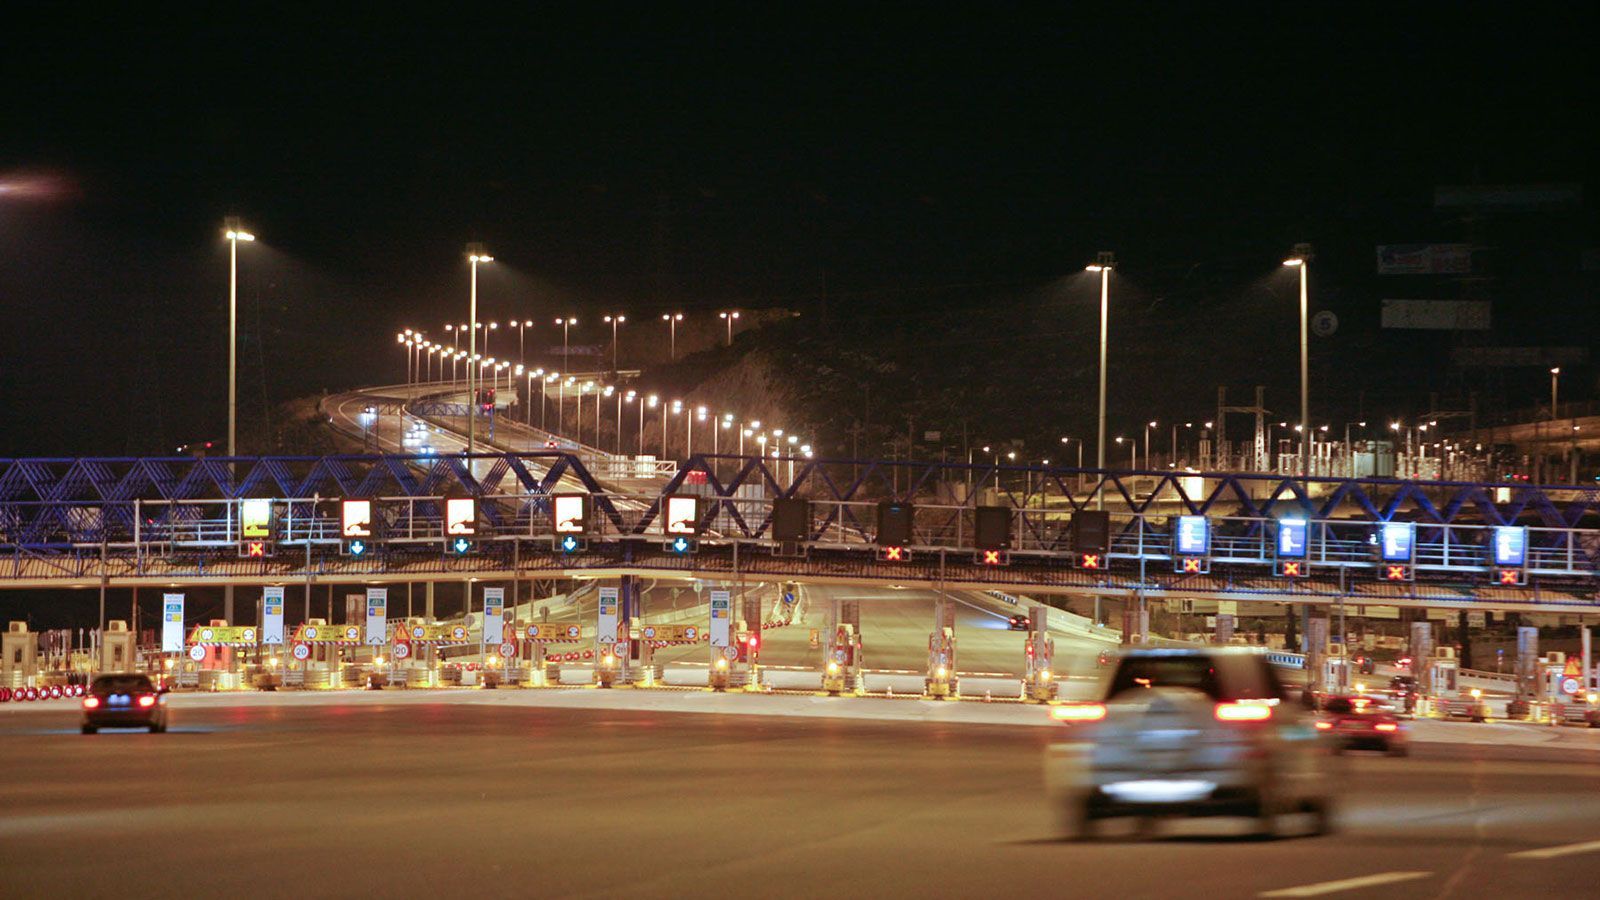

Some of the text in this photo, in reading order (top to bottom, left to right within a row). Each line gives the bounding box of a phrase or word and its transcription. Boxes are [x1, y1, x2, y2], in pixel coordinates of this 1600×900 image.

[192, 649, 203, 657] 20
[296, 648, 307, 656] 20
[396, 647, 406, 655] 20
